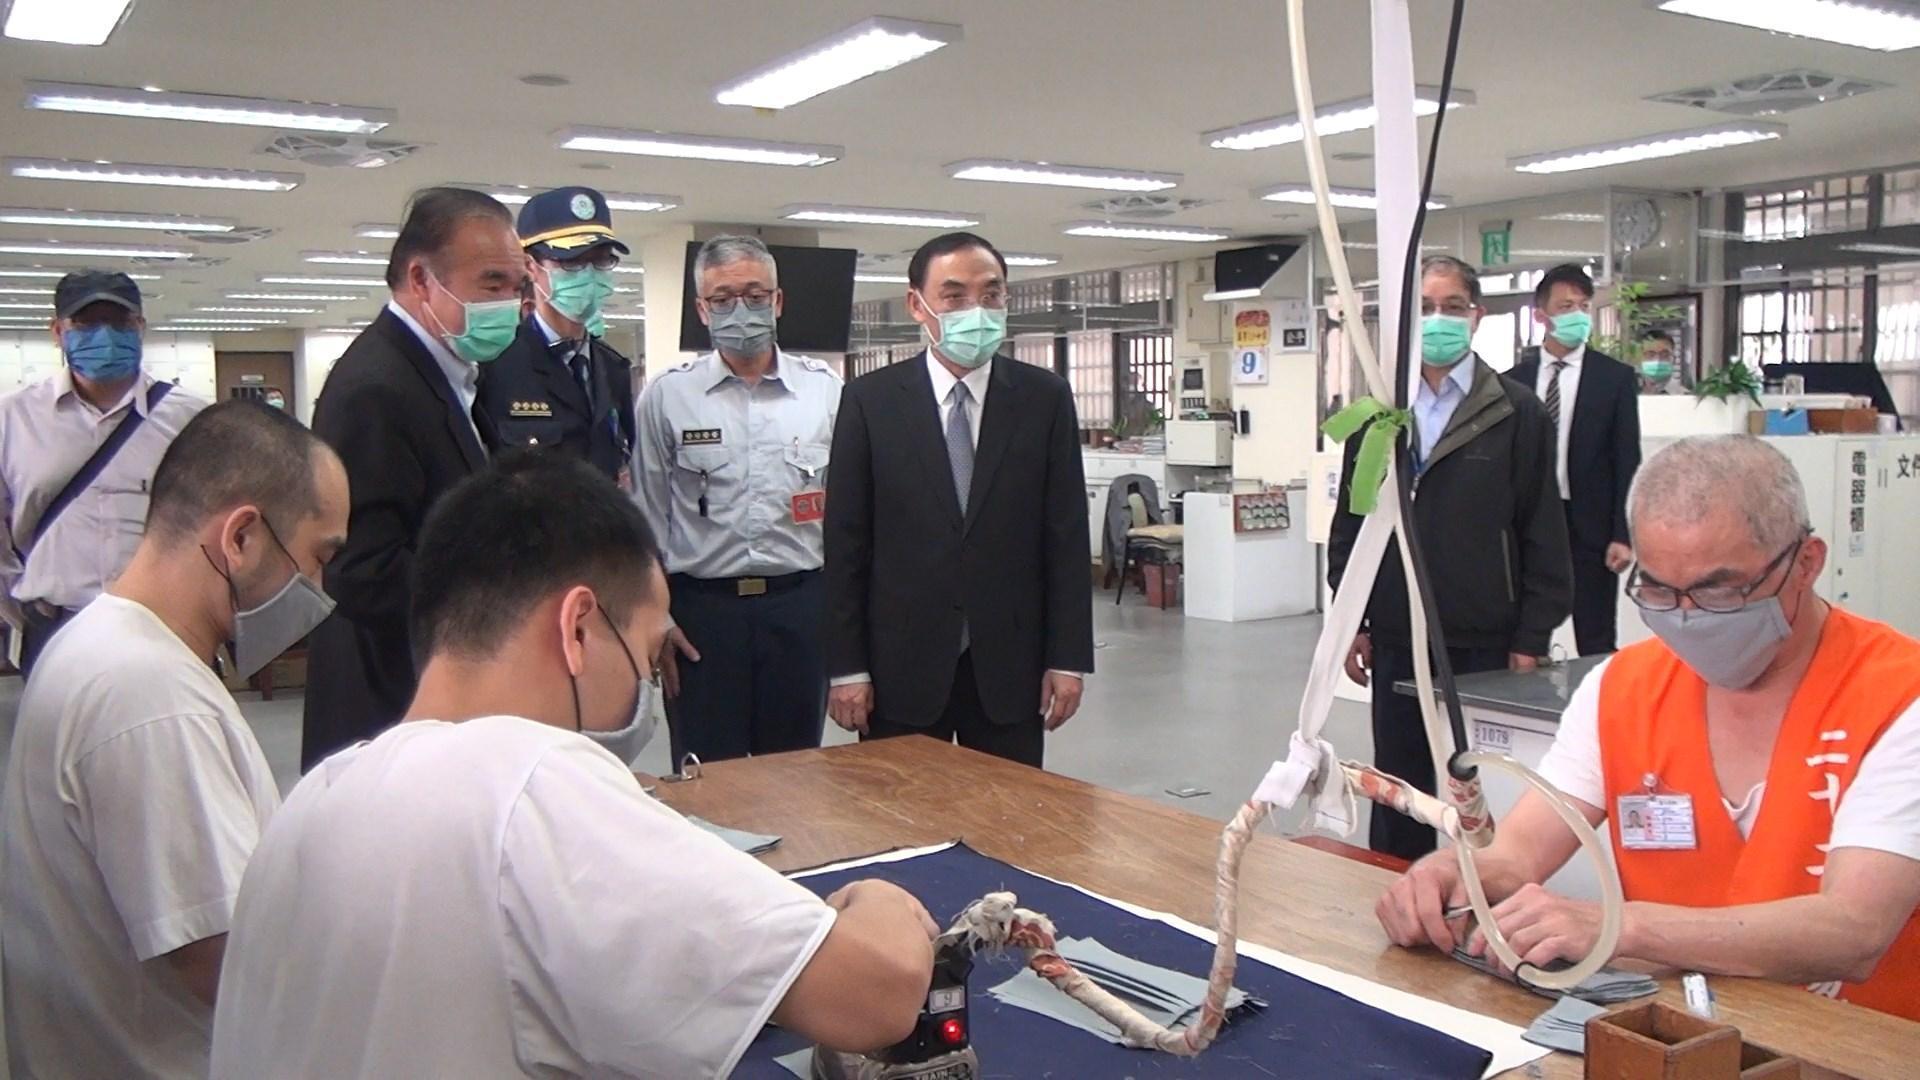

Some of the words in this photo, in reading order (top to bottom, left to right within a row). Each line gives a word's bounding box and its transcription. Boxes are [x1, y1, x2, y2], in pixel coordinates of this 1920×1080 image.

[1242, 352, 1256, 374] 9
[1850, 451, 1866, 533] 電器櫃
